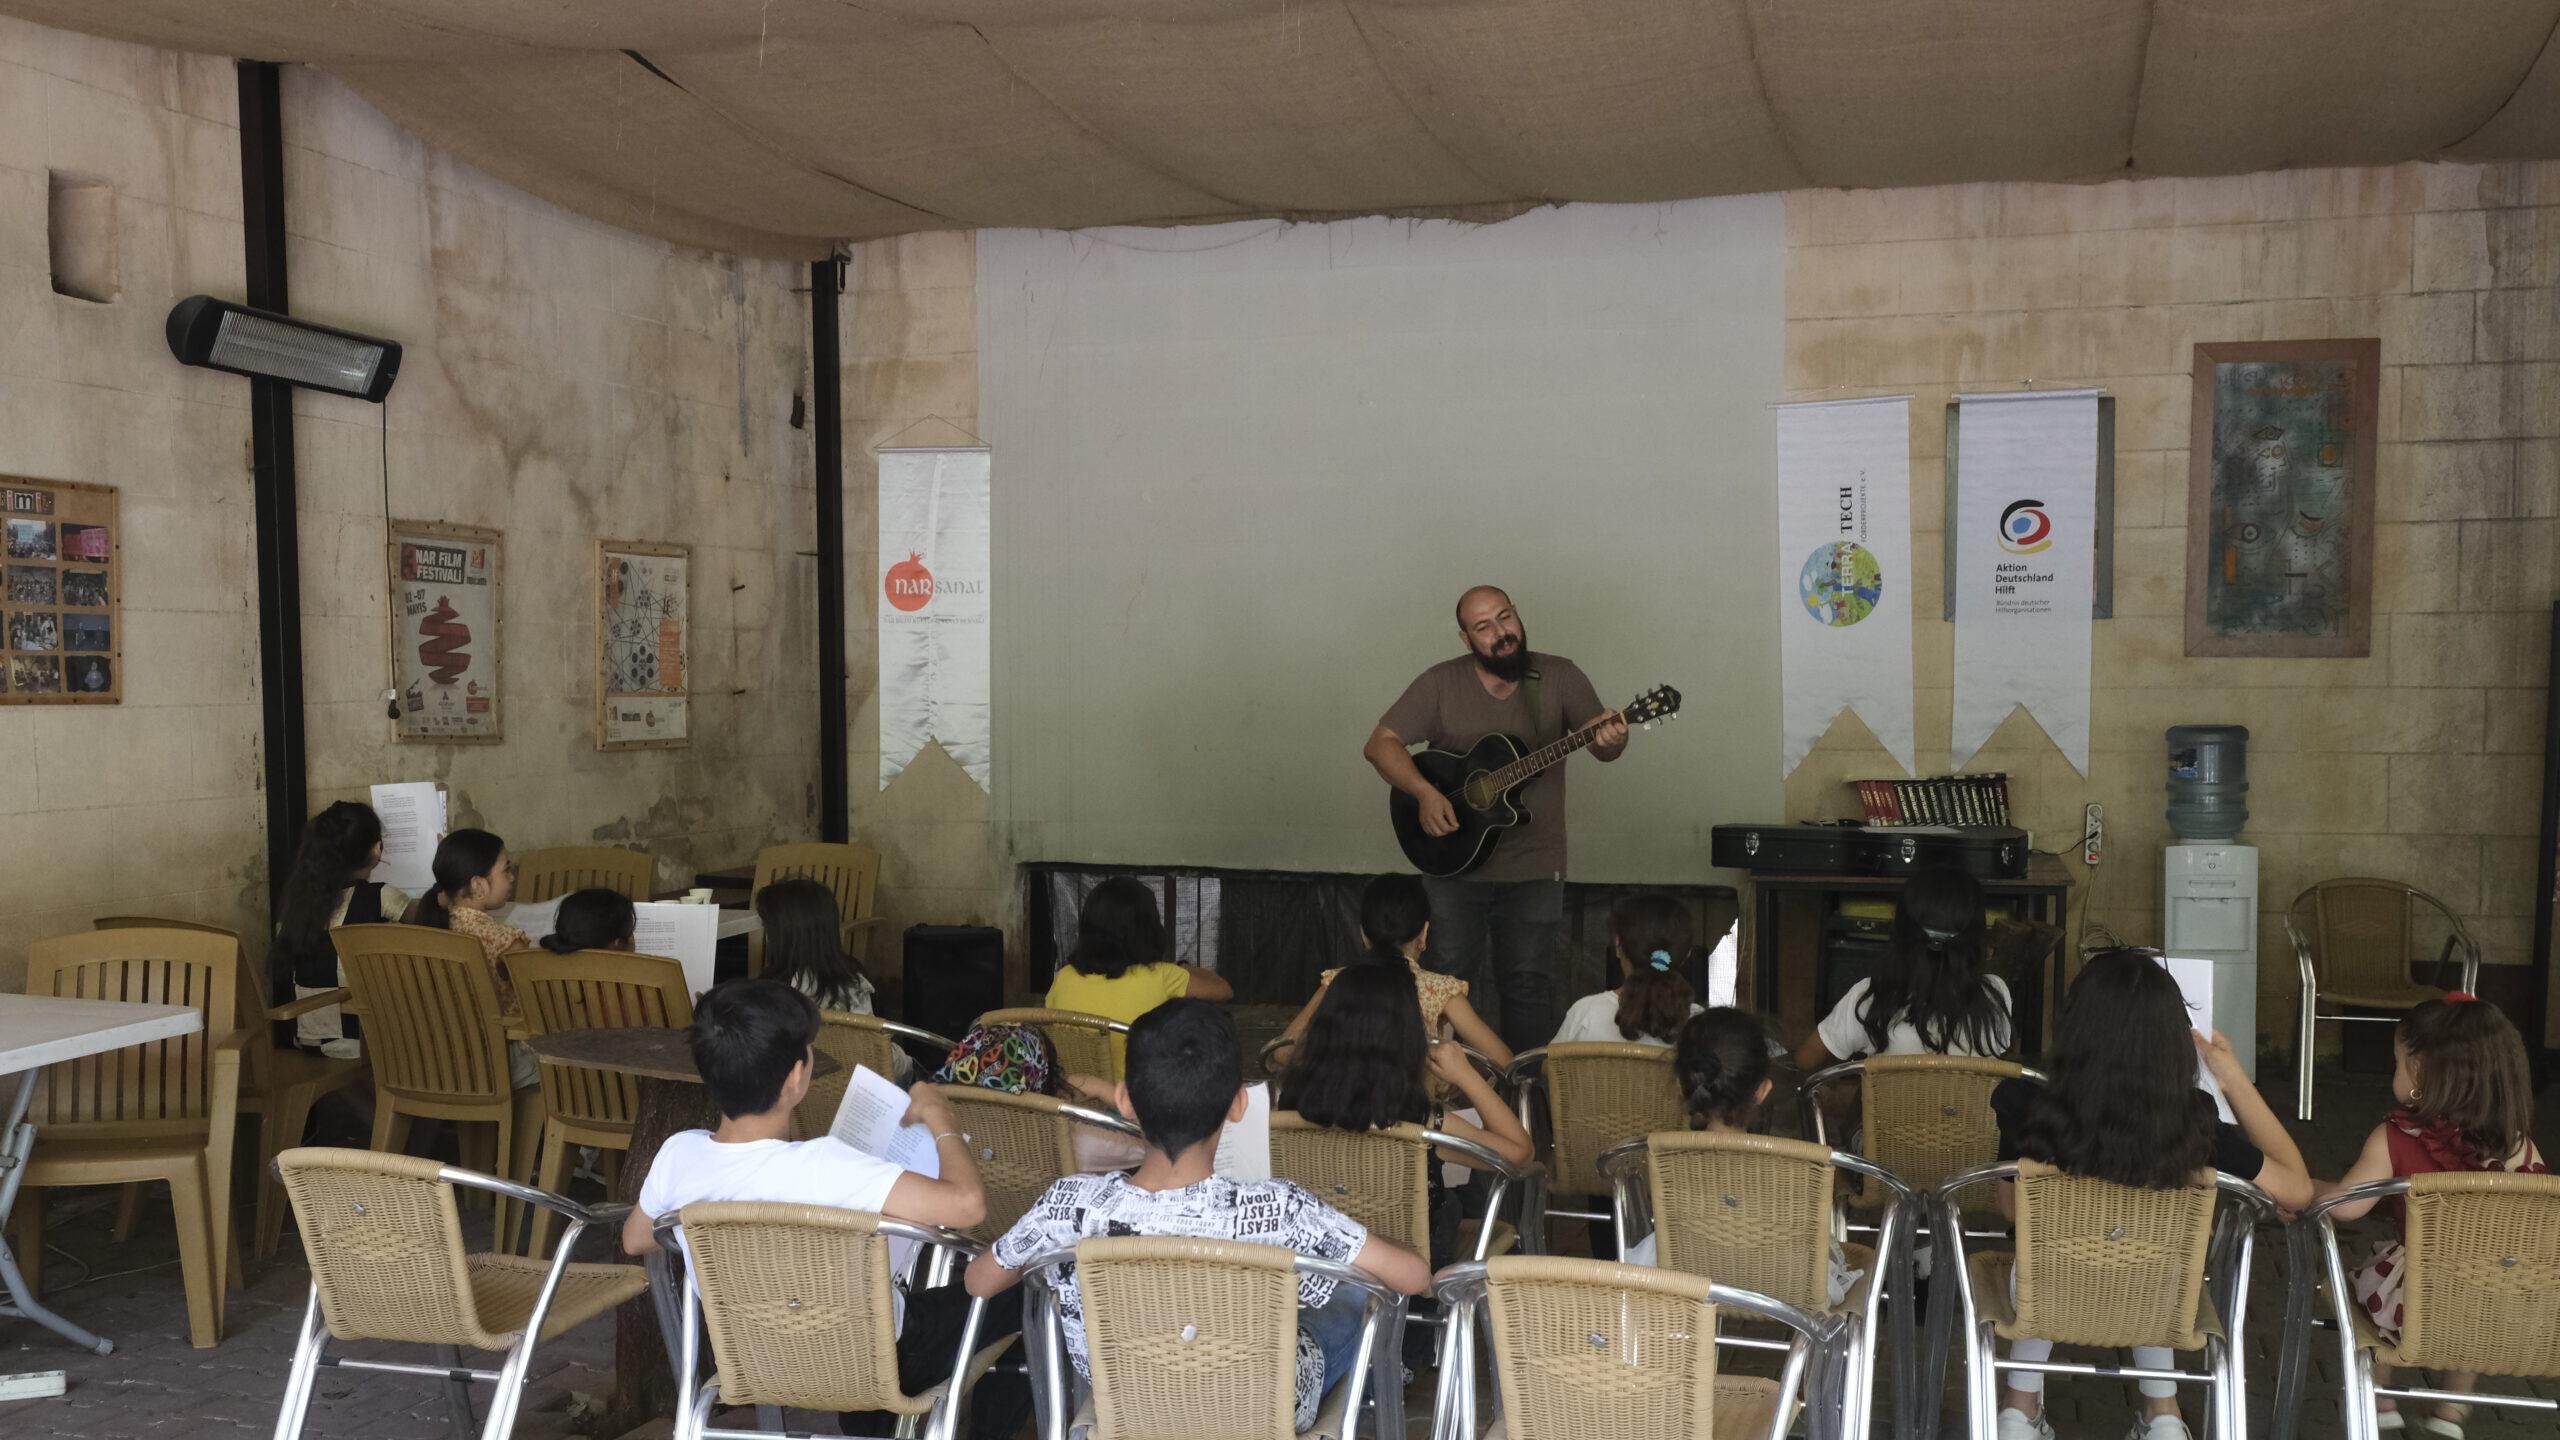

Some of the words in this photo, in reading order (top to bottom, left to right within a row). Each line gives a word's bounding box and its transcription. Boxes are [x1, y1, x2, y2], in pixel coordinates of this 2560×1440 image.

[1840, 486, 1852, 534] TECH
[416, 549, 436, 566] NAR
[1841, 542, 1854, 597] TERRA
[1997, 563, 2027, 572] Aktion
[1995, 573, 2053, 582] Deutschland
[1995, 585, 2016, 594] Hilft
[1240, 1190, 1278, 1207] TODAY
[1241, 1203, 1281, 1220] FEAST
[1239, 1218, 1279, 1236] BEAST
